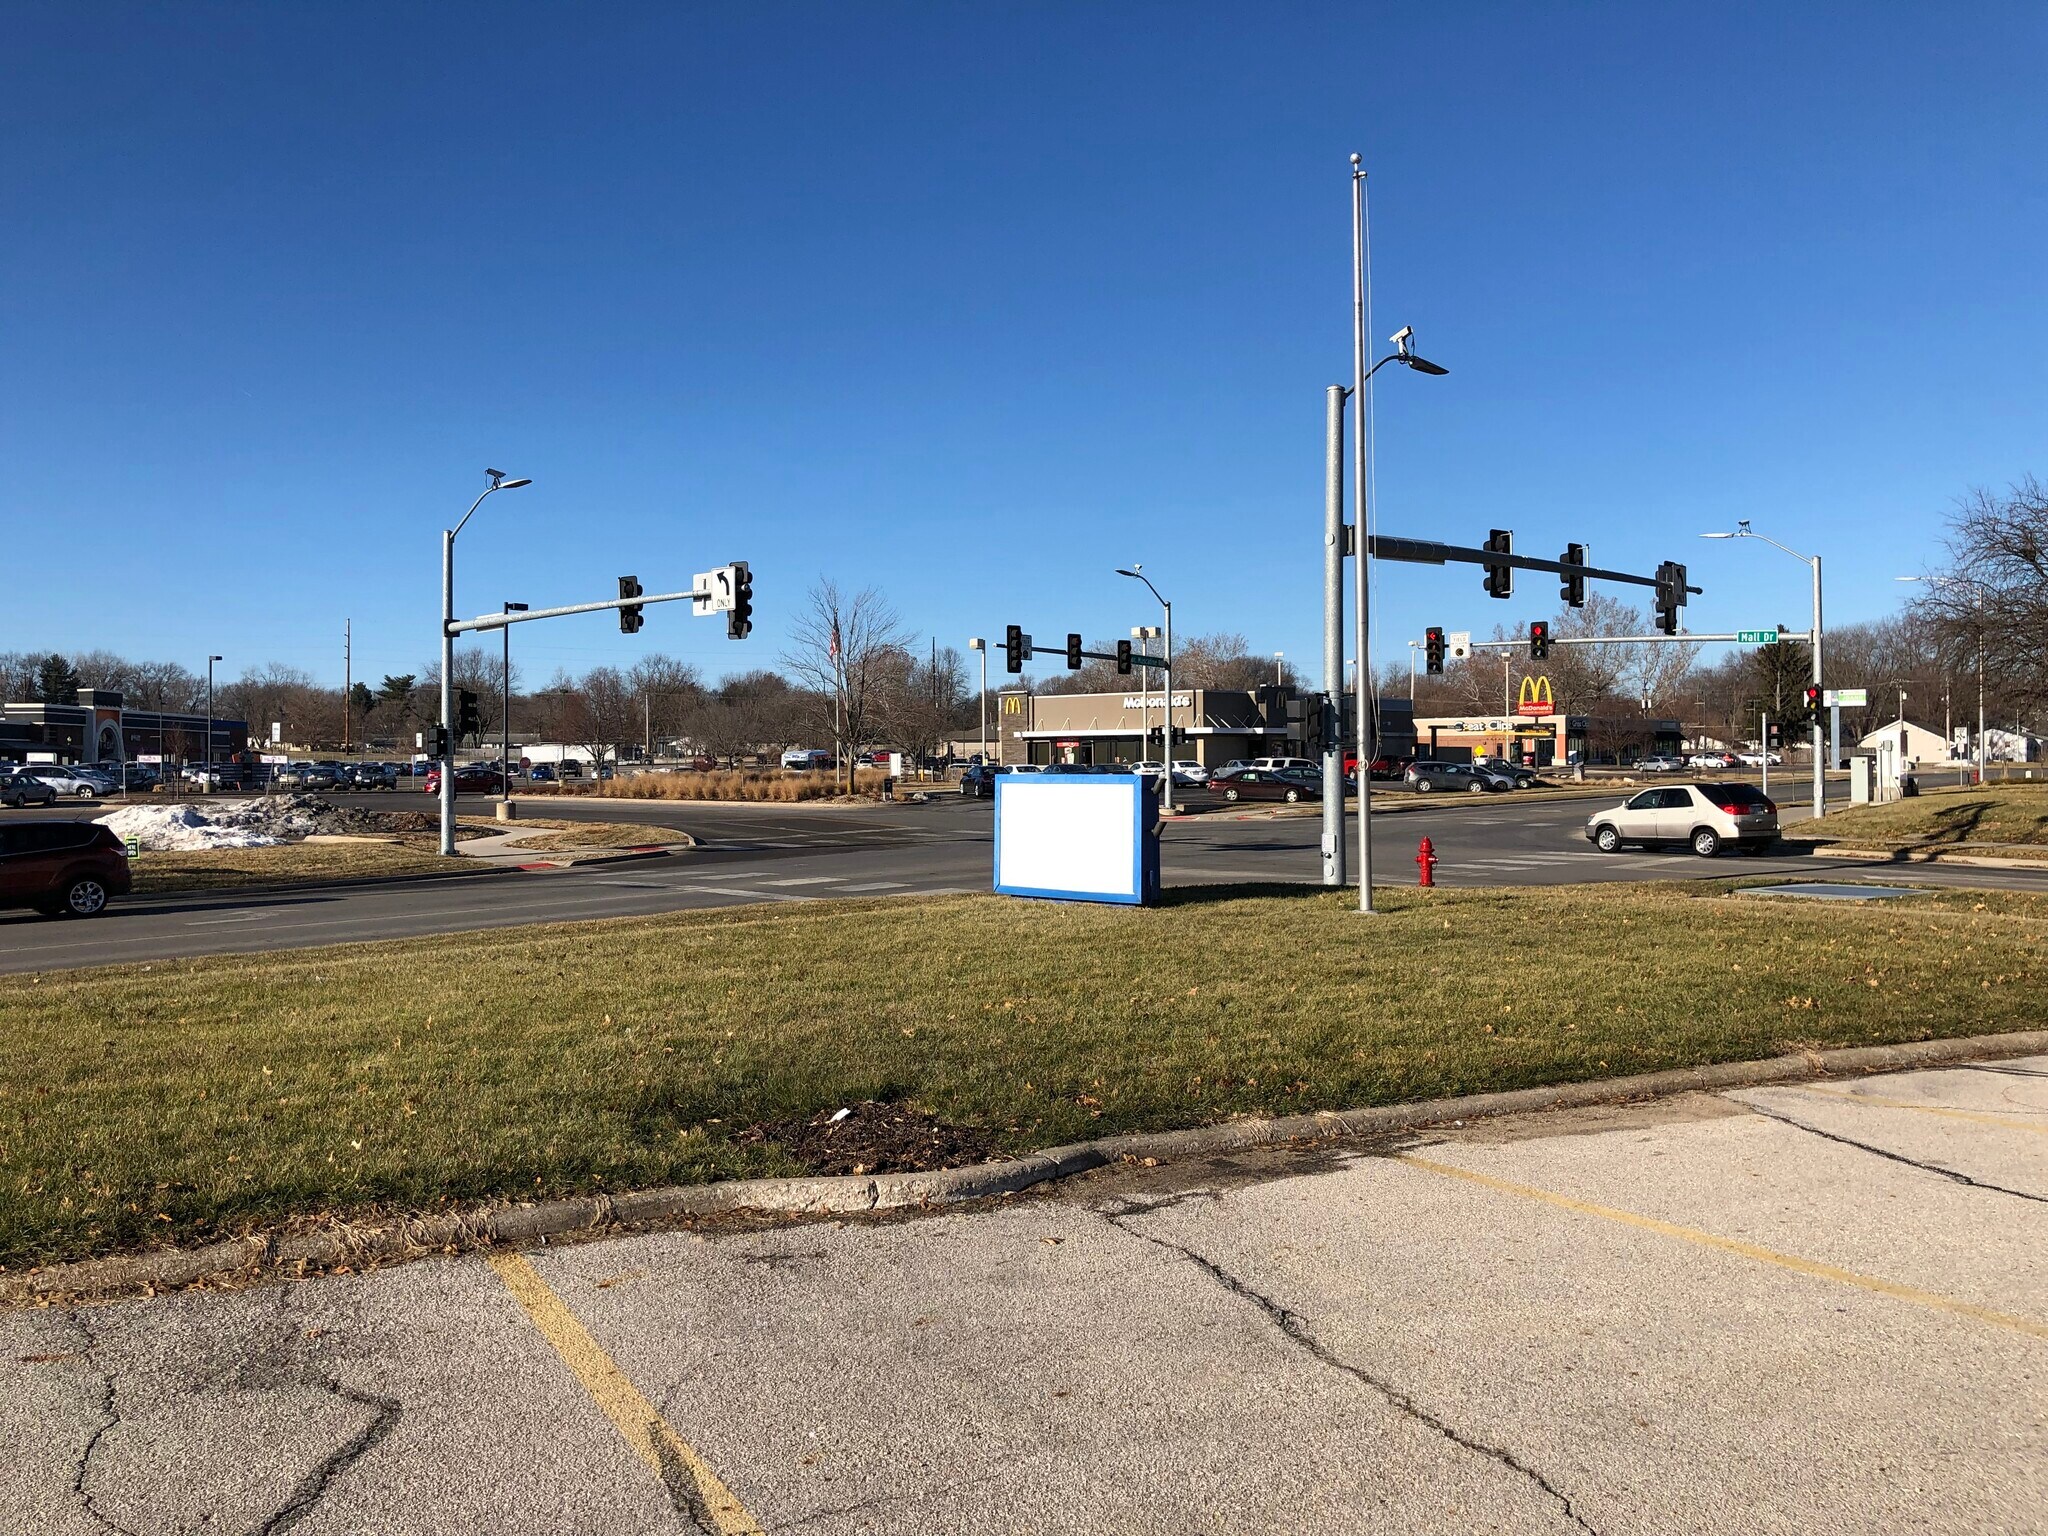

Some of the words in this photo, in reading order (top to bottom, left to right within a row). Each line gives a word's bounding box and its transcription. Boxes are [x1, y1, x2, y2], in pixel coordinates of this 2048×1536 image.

[717, 598, 731, 608] ONLY
[1741, 632, 1760, 642] Mall
[1763, 632, 1774, 642] Dr
[1454, 720, 1486, 732] Great
[1488, 719, 1514, 732] Clips
